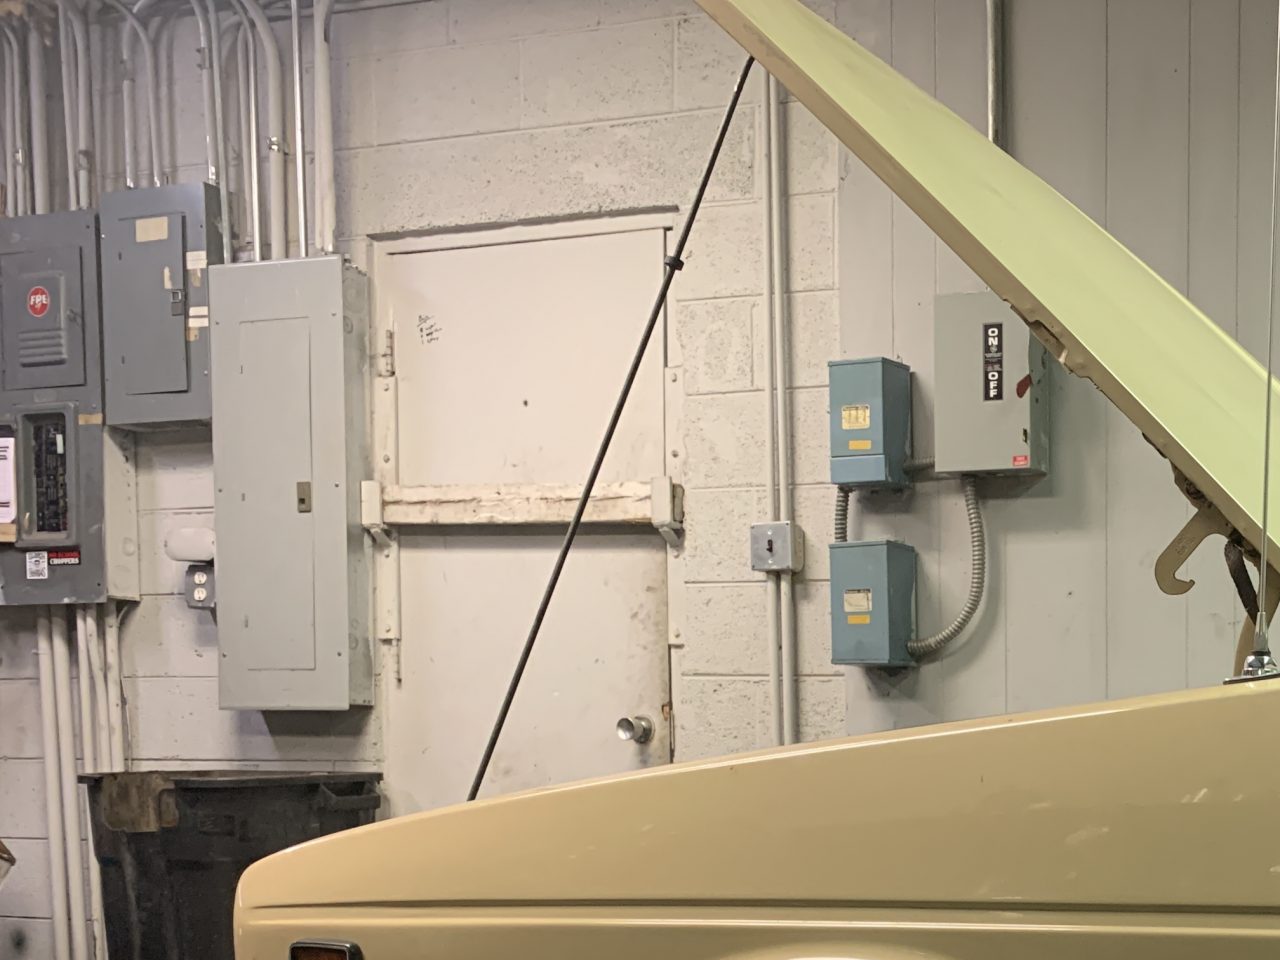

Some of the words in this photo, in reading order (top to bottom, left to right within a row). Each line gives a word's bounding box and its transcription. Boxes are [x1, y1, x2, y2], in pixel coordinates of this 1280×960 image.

[30, 294, 48, 305] FPE
[987, 327, 999, 346] ON
[987, 371, 999, 398] OFF
